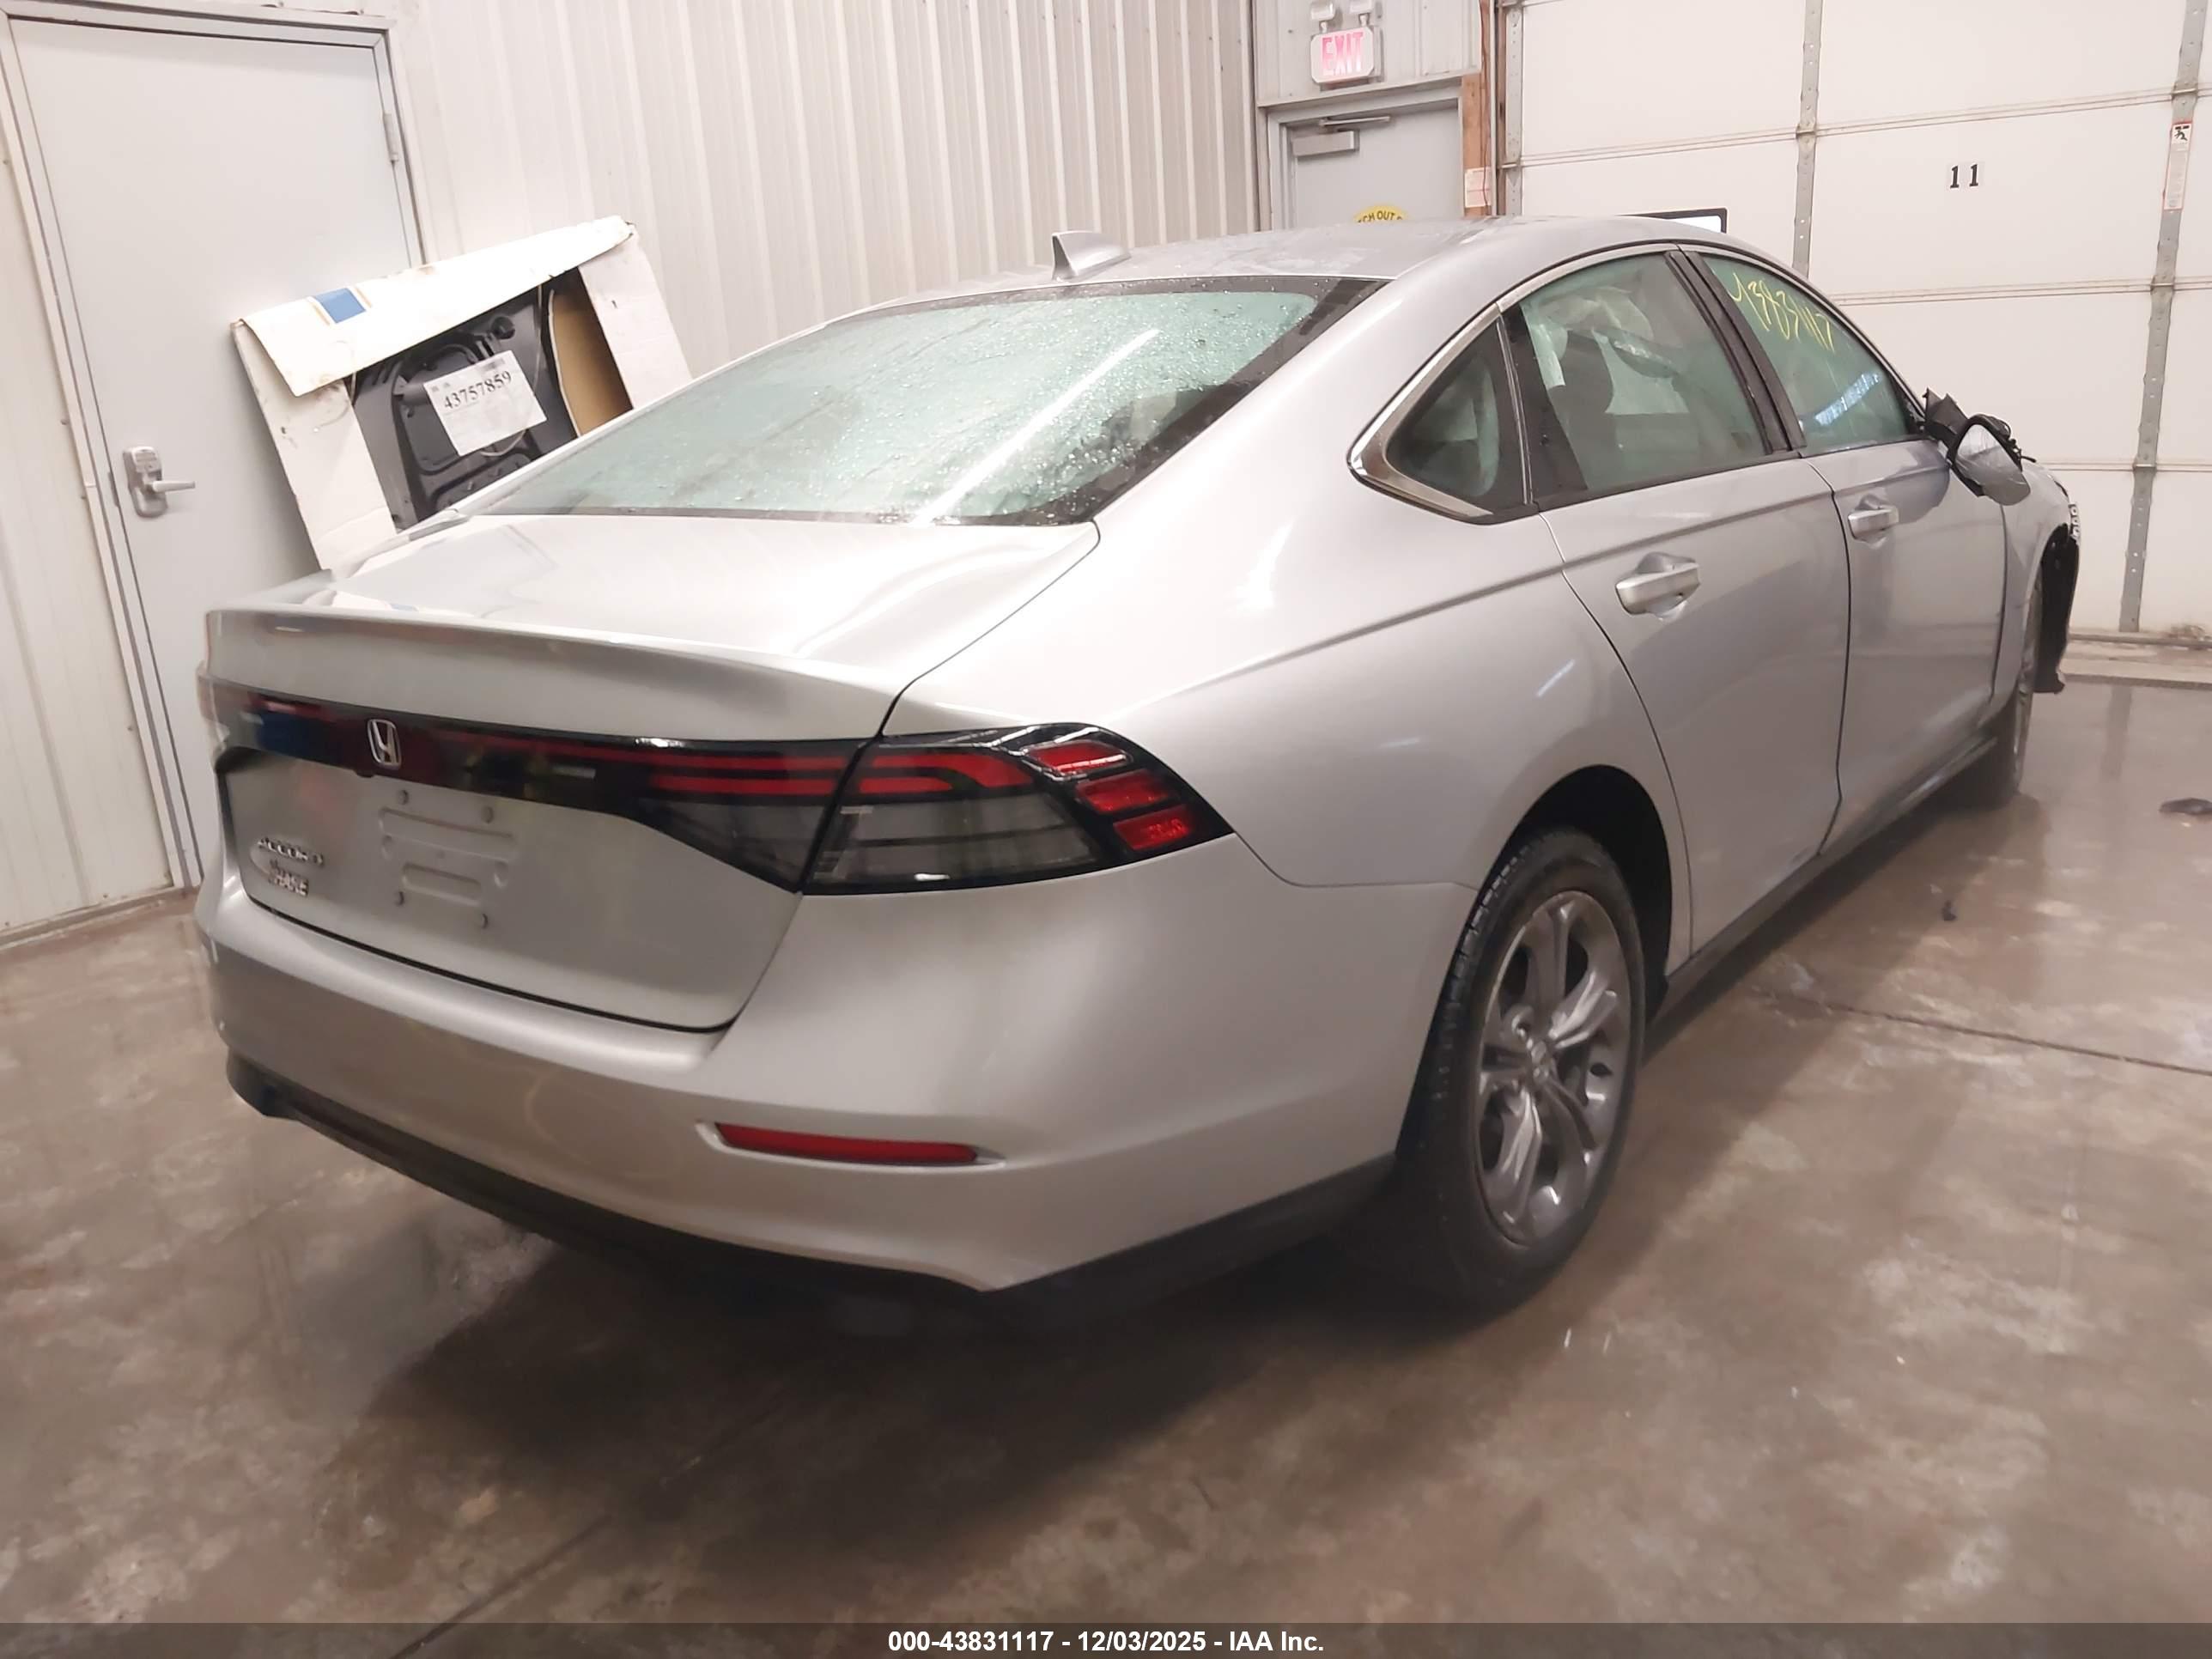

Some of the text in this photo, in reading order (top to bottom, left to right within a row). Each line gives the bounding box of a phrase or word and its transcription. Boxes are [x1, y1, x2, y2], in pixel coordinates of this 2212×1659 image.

[1322, 32, 1364, 76] EXIT
[1950, 164, 1978, 189] 11
[444, 370, 513, 410] 43757859
